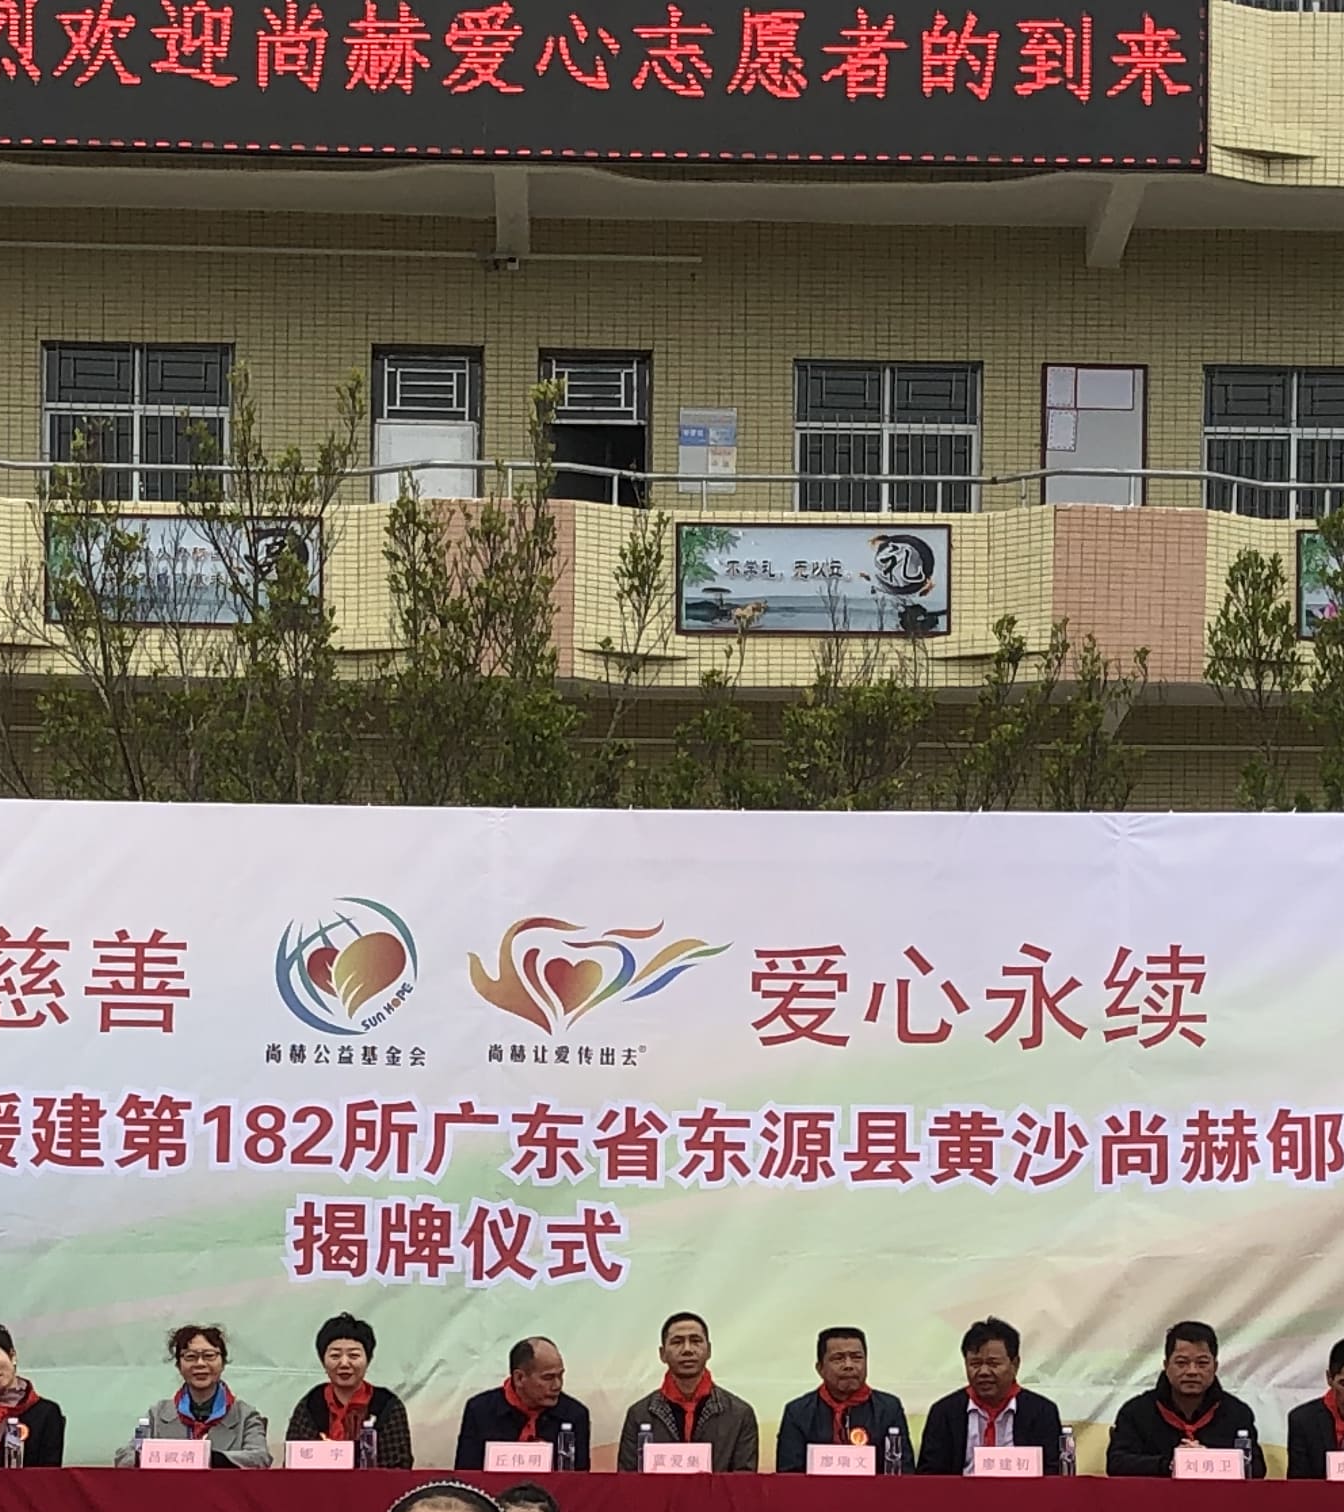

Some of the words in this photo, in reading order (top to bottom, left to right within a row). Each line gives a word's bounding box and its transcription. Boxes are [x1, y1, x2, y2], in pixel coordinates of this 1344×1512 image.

[878, 542, 926, 583] 礼
[361, 1011, 386, 1031] SUN
[383, 982, 413, 1015] HOPE
[750, 943, 1210, 1050] 爱心永续
[266, 1043, 426, 1066] 尚赫公益基金会
[294, 1206, 623, 1282] 揭牌仪式
